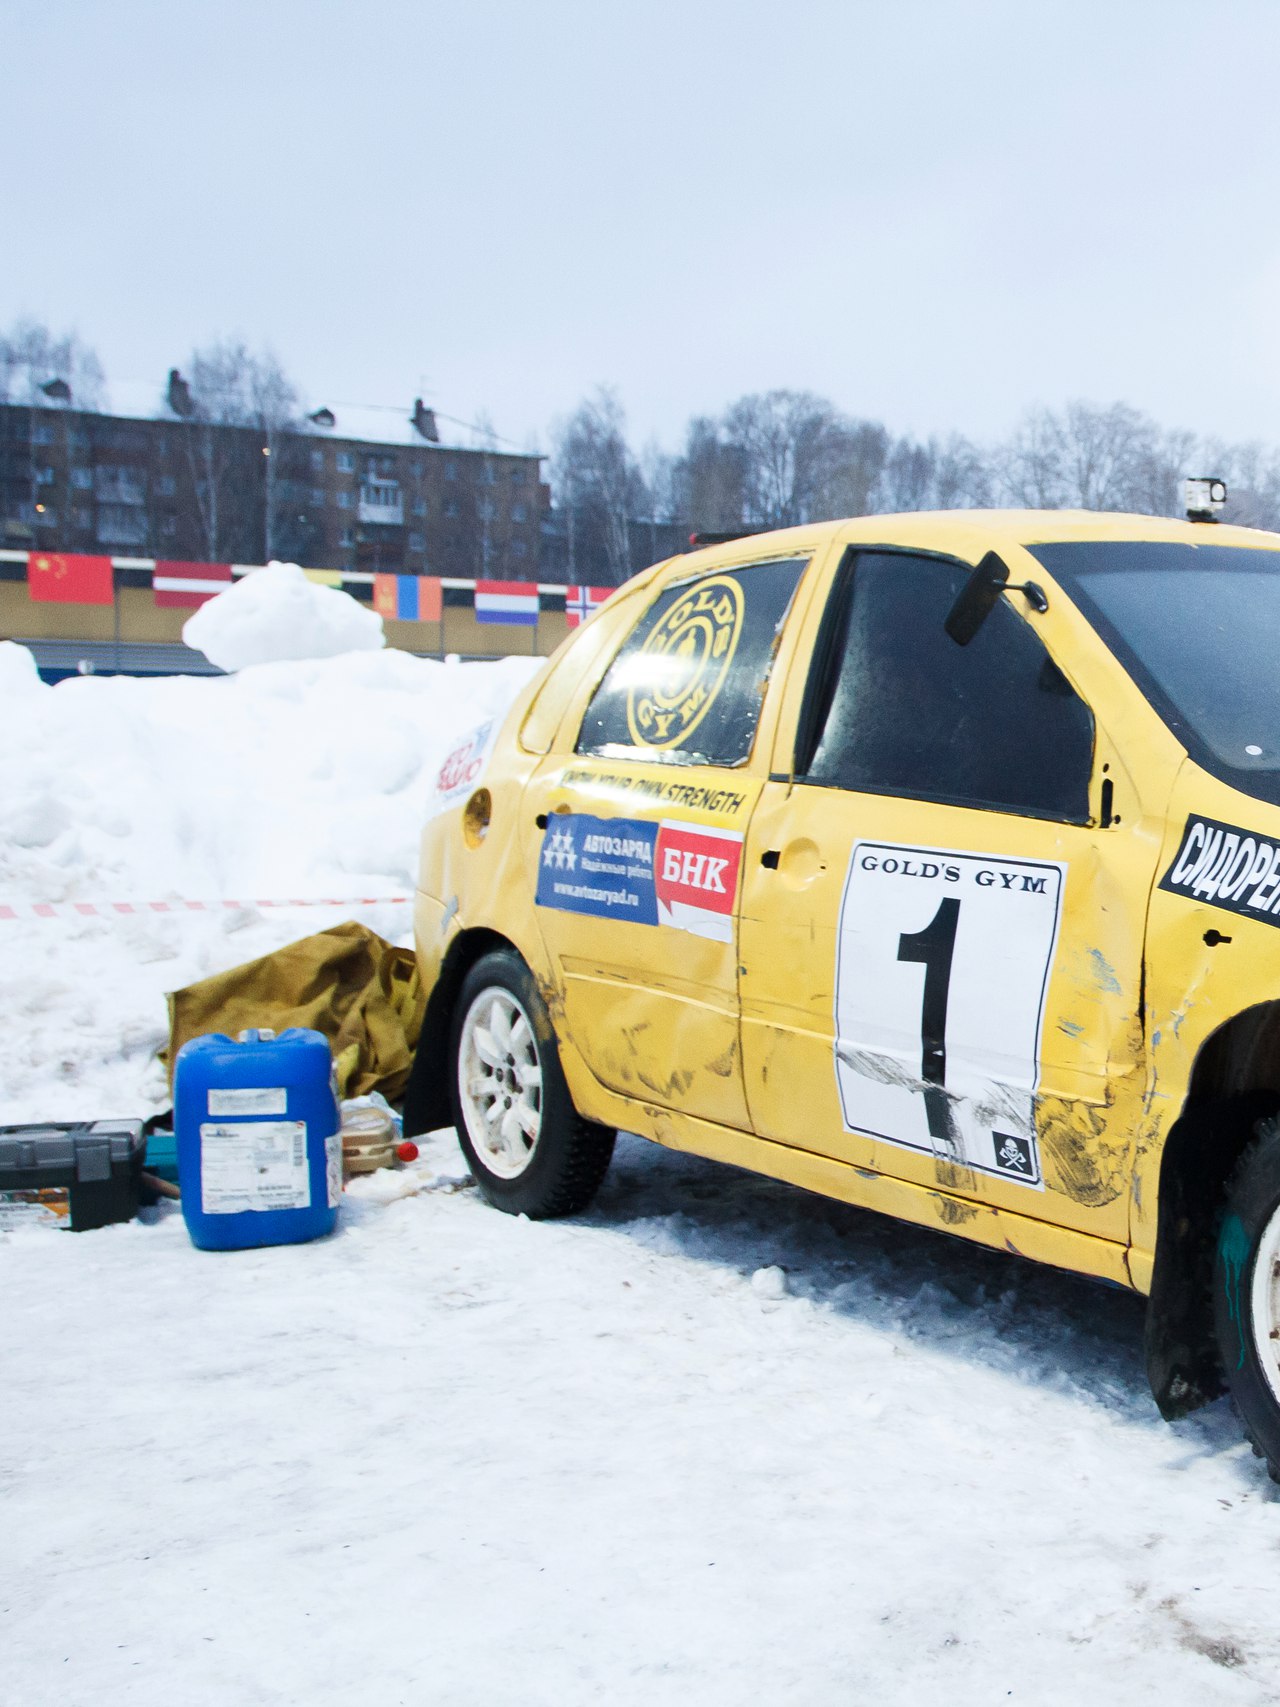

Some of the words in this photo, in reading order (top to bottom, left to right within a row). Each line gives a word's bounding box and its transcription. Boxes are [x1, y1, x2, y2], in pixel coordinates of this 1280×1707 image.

[666, 783, 747, 815] STRENGTH
[582, 834, 652, 865] АВТОЗАРЯД
[662, 847, 730, 894] БНК
[860, 854, 962, 883] GOLD'S
[975, 869, 1049, 896] GYM
[896, 896, 962, 1142] 1
